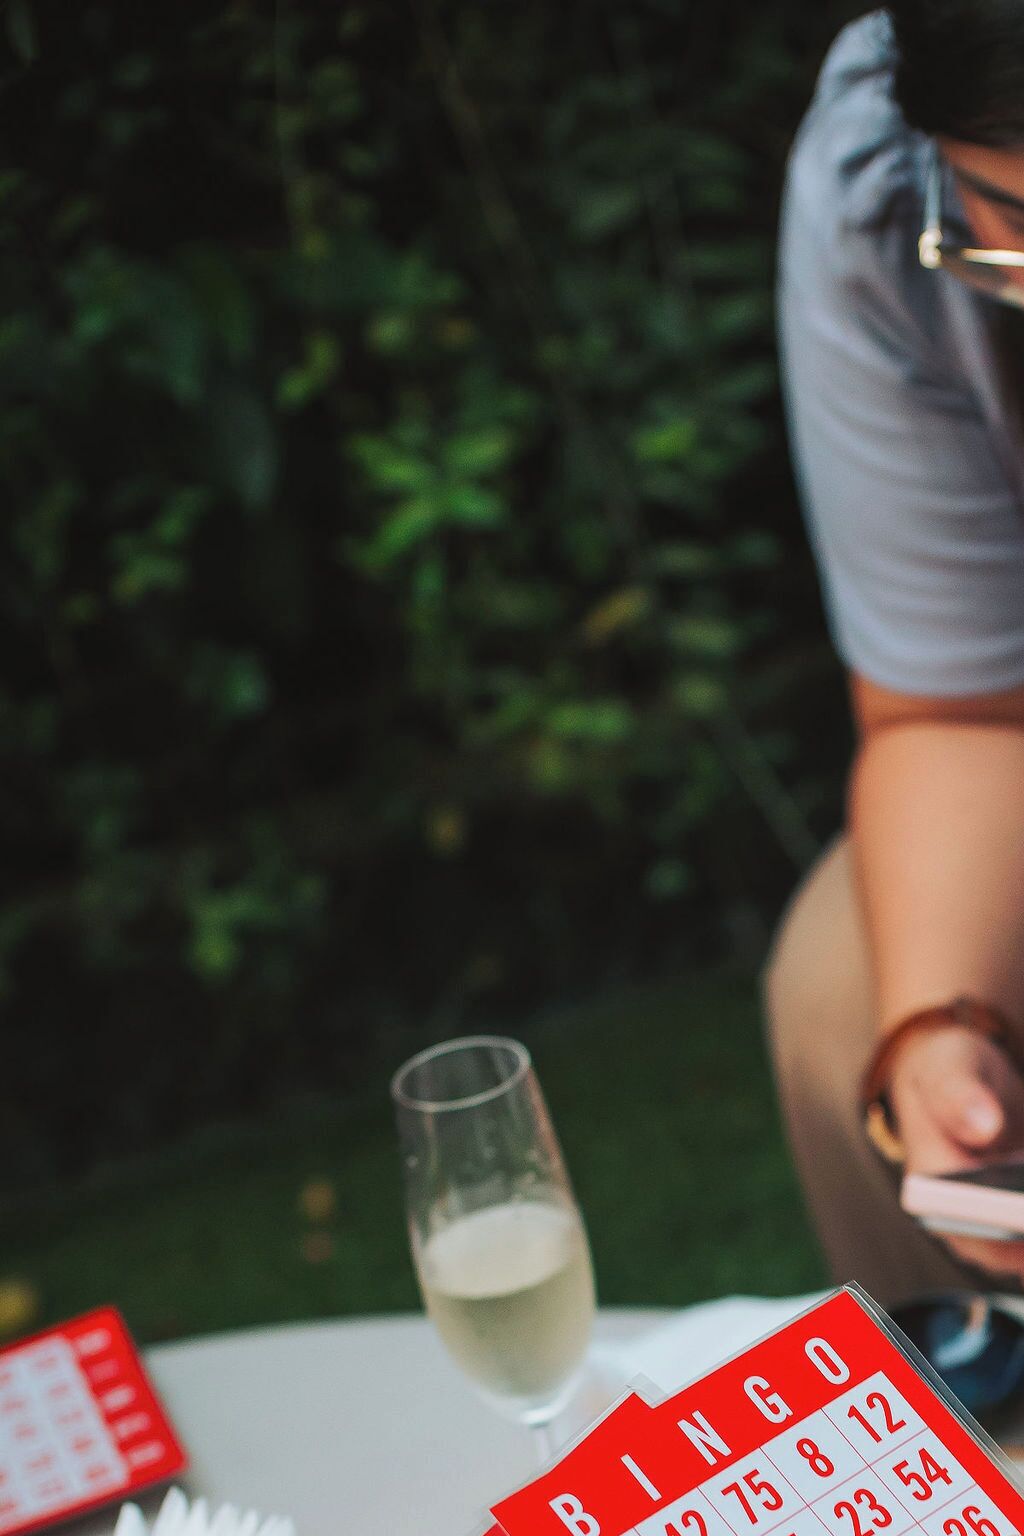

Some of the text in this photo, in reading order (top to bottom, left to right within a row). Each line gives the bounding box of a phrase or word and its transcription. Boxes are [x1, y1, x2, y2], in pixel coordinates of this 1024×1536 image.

[721, 1468, 784, 1525] 75
[795, 1437, 835, 1478] 8
[847, 1391, 907, 1443] 12
[892, 1447, 953, 1502] 54
